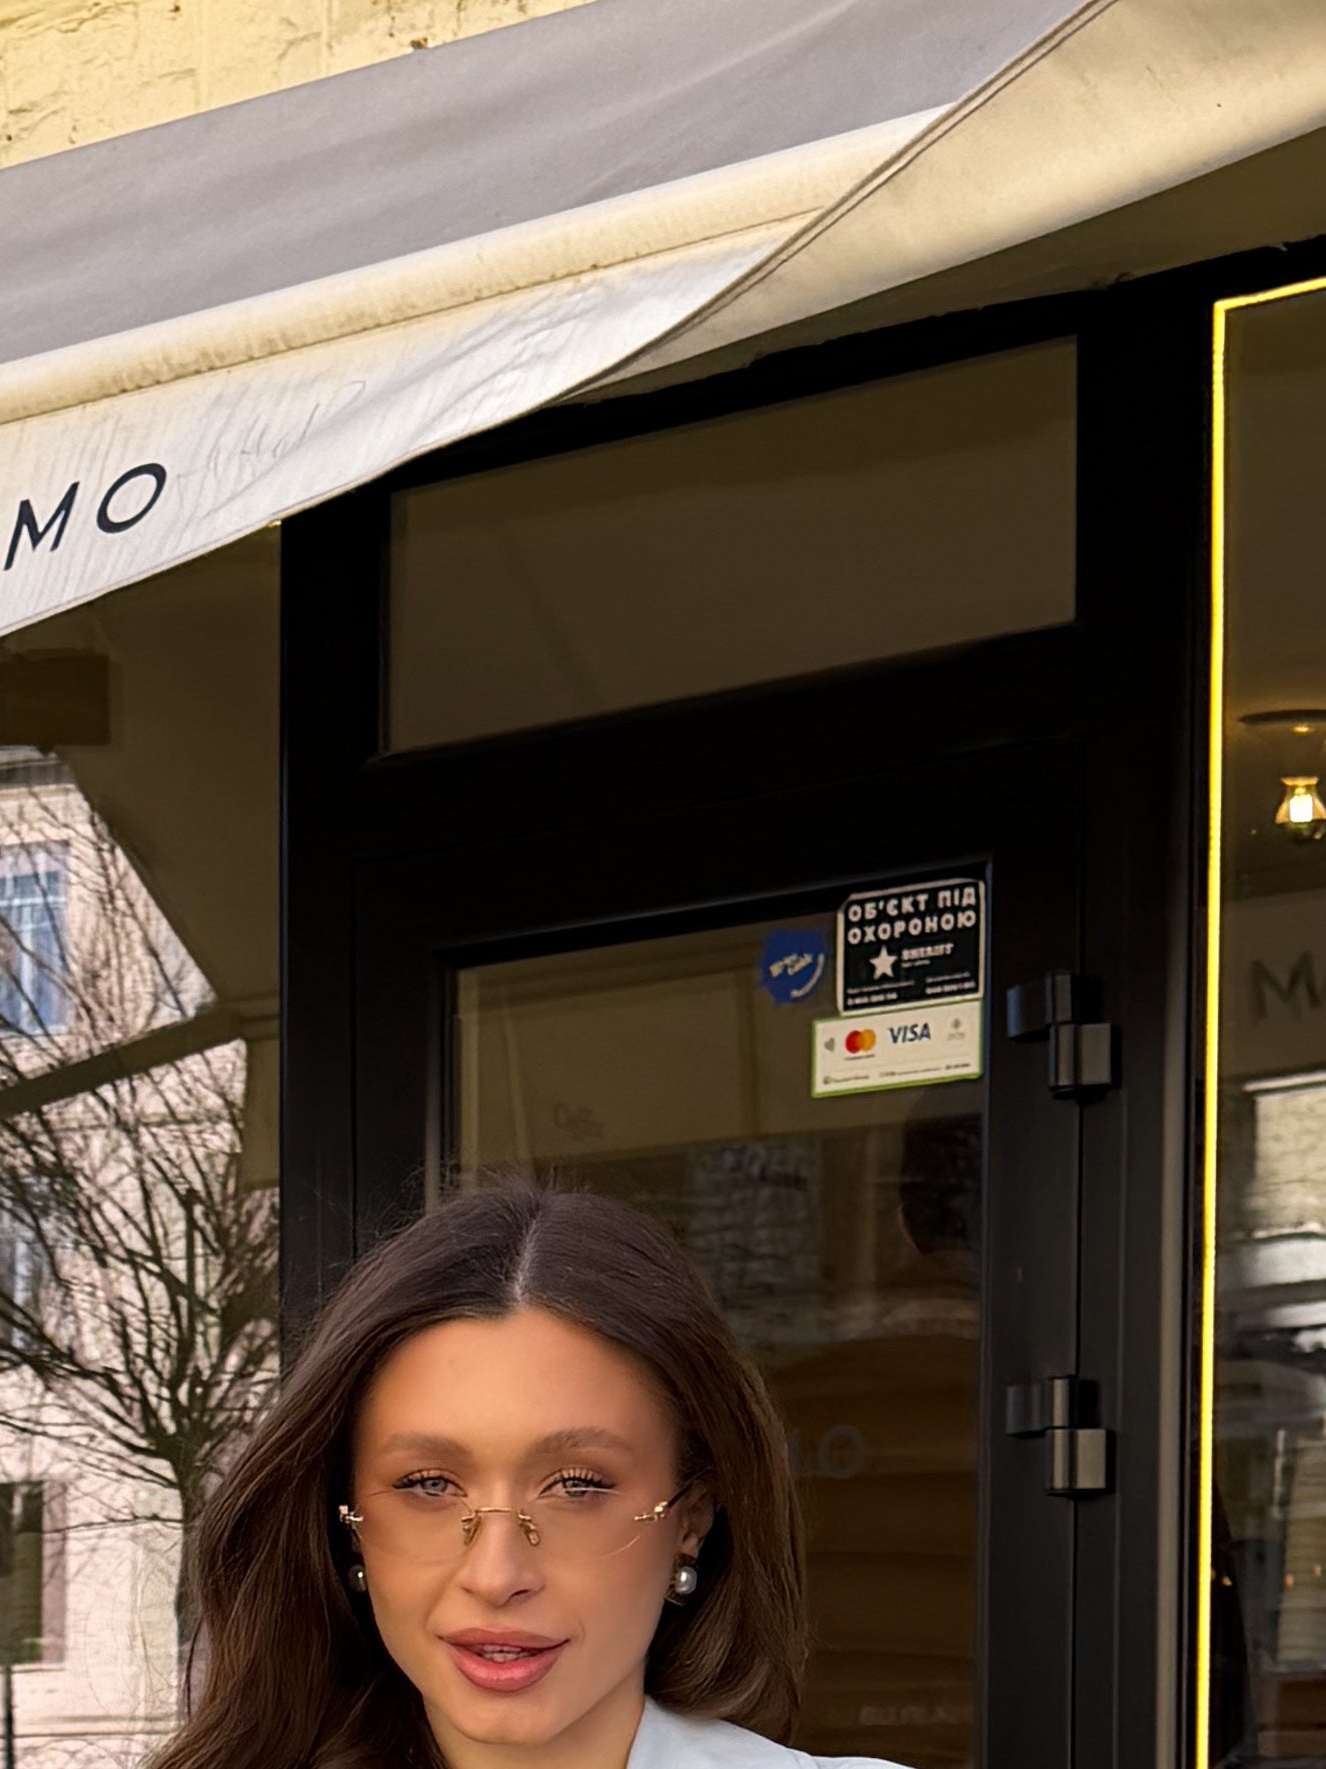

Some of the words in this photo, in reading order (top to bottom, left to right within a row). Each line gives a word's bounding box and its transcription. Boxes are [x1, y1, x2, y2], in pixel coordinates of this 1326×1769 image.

[937, 886, 977, 909] ПІД
[847, 909, 977, 945] ОХОРОНОЮ
[888, 1022, 932, 1044] VISA
